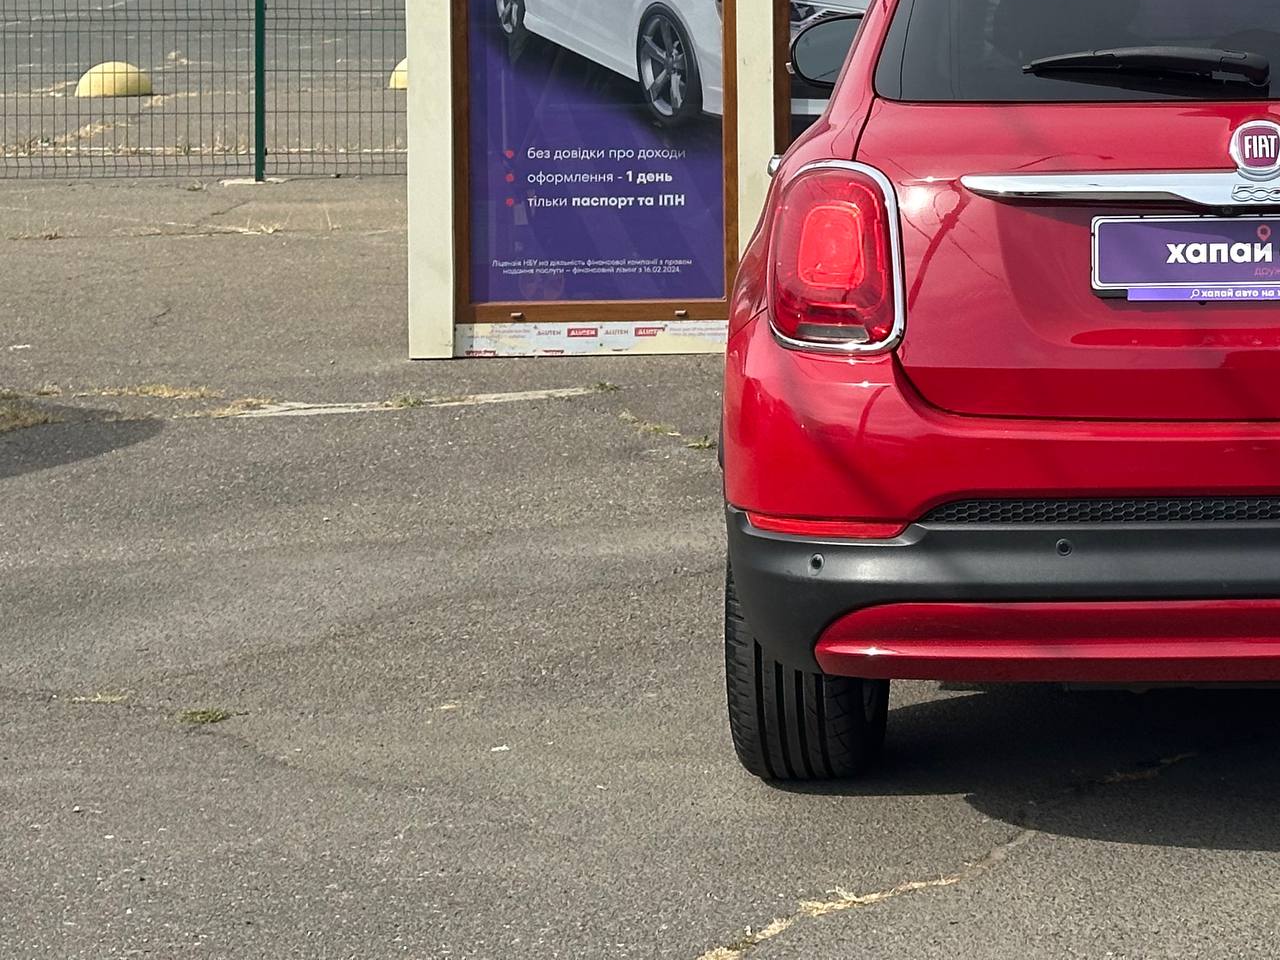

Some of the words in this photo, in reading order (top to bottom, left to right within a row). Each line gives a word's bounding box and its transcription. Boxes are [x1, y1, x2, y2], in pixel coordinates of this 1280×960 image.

[527, 147, 551, 159] без
[554, 147, 605, 160] довідки
[609, 150, 634, 161] про
[638, 149, 686, 160] доходи
[1244, 135, 1278, 159] FIAT
[527, 171, 614, 185] оформлення
[626, 171, 633, 182] 1
[637, 172, 673, 184] день
[527, 195, 567, 207] тільки
[572, 196, 634, 209] паспорт
[637, 197, 654, 206] та
[659, 195, 685, 206] ІПН
[1201, 288, 1233, 298] хапай
[1262, 289, 1274, 297] на
